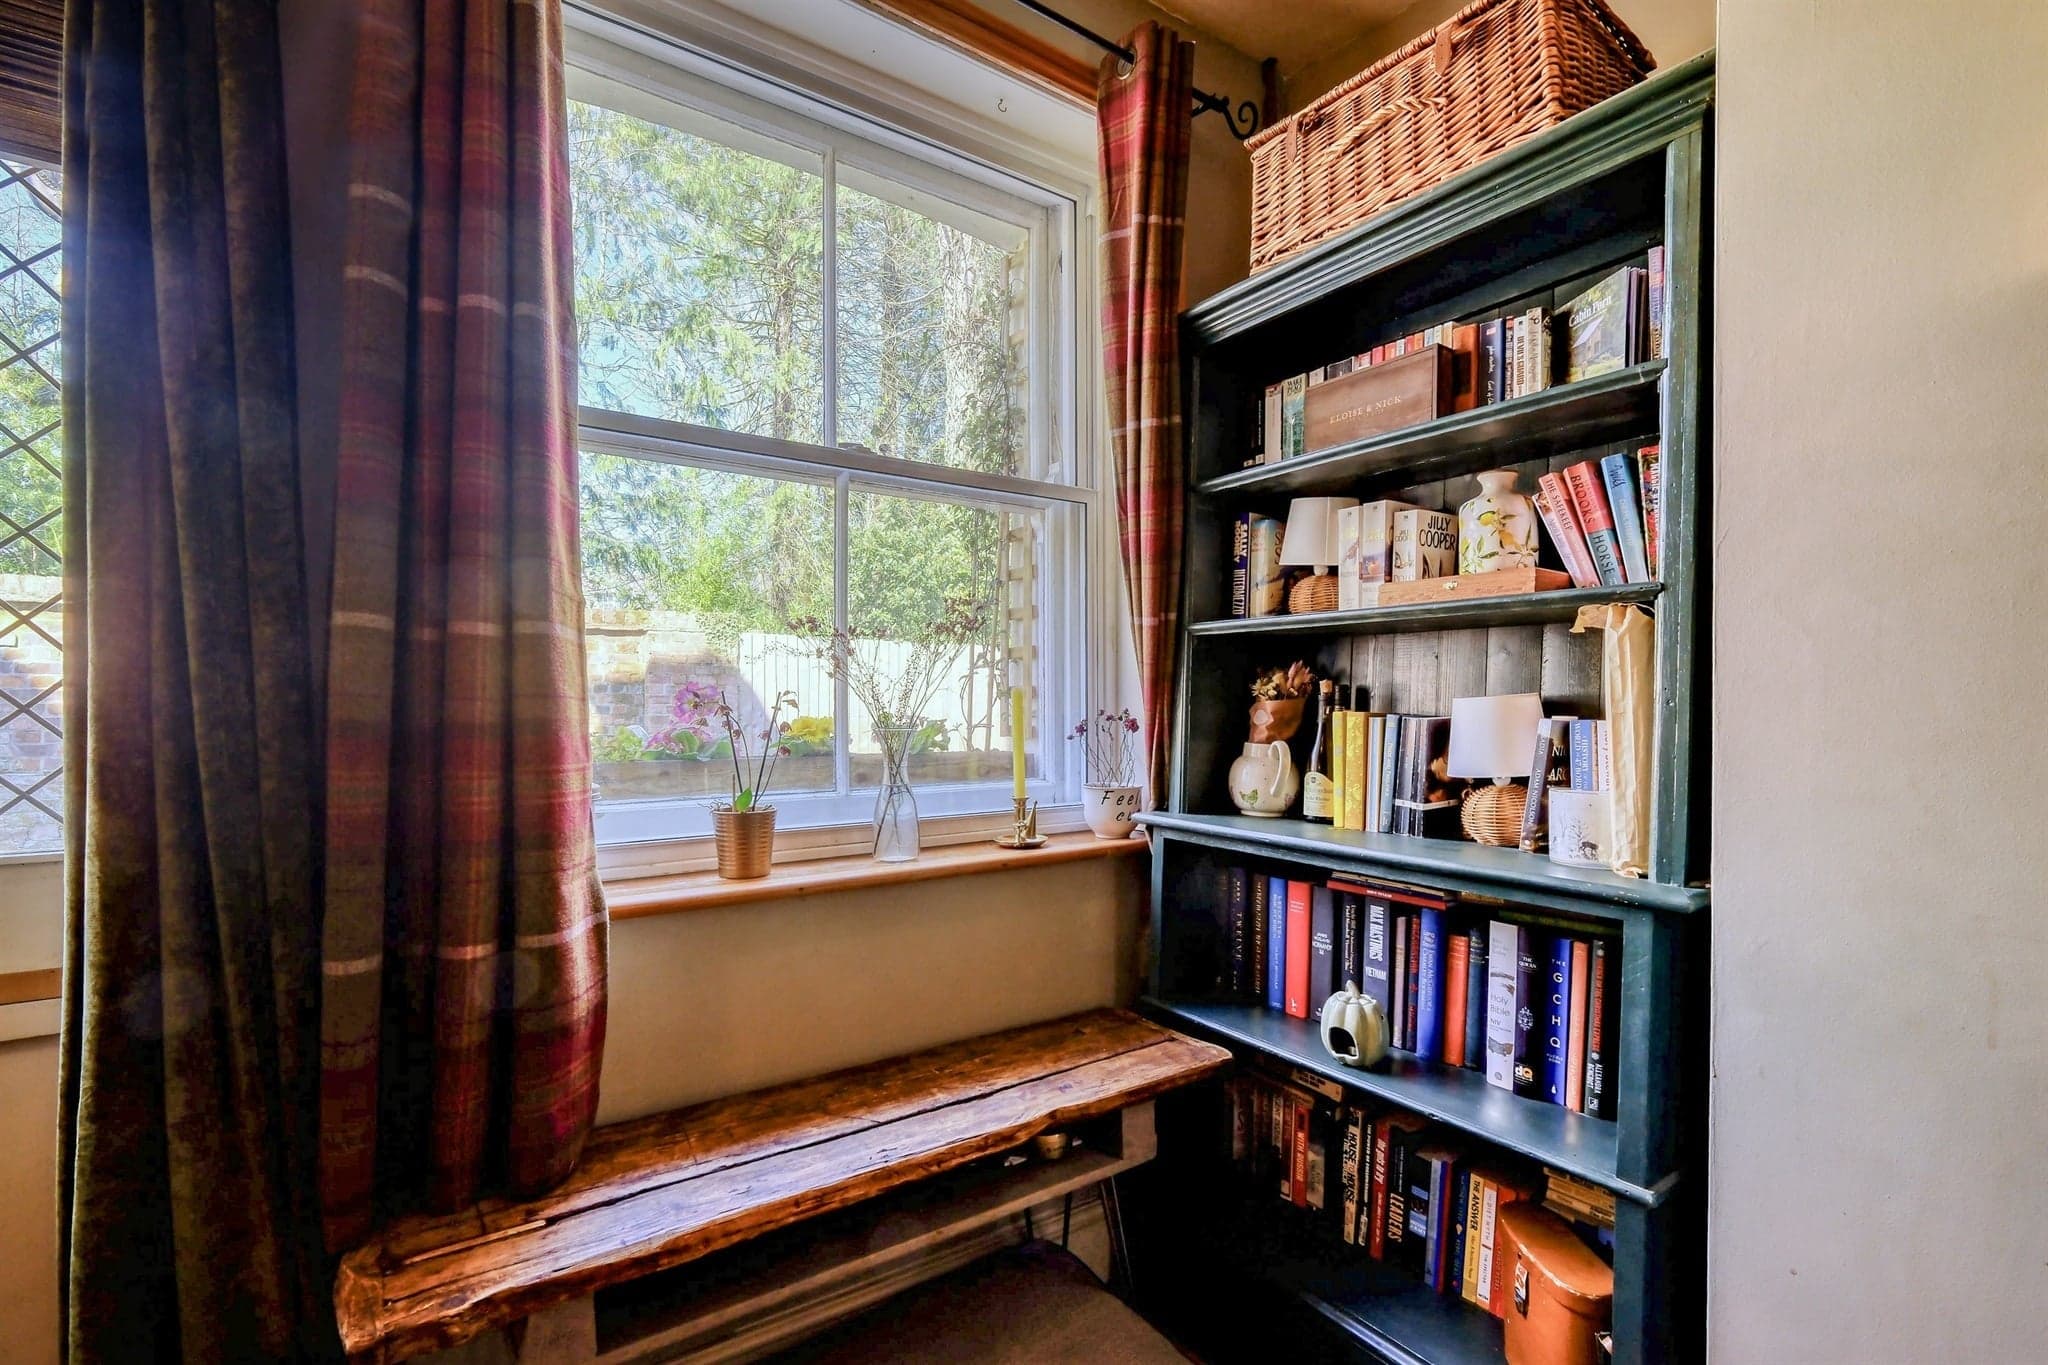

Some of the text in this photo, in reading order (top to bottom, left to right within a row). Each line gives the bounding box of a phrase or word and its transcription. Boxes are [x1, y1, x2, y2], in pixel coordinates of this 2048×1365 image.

[1569, 308, 1592, 327] Cabin
[1329, 407, 1364, 424] ELOISE
[1375, 395, 1401, 410] NICK
[1546, 478, 1556, 493] THE
[1571, 474, 1596, 524] BROOKS
[1428, 515, 1452, 532] JILLY
[1240, 523, 1248, 557] SALLY
[1419, 529, 1456, 551] COOPER
[1593, 534, 1616, 575] HORSE
[1527, 787, 1539, 825] NICOLSON
[1370, 904, 1384, 923] MAX
[1369, 923, 1384, 961] HASTINGS
[1365, 966, 1387, 981] VIETNAM
[1551, 959, 1566, 967] THE
[1490, 994, 1509, 1006] Holy
[1490, 1004, 1511, 1017] Bible
[1594, 1063, 1604, 1095] ALEXANDRA
[1348, 1133, 1358, 1162] HOUSE
[1346, 1173, 1356, 1205] HOUSE
[1388, 1193, 1405, 1243] LEADERS
[1470, 1180, 1481, 1231] THE ANSWER
